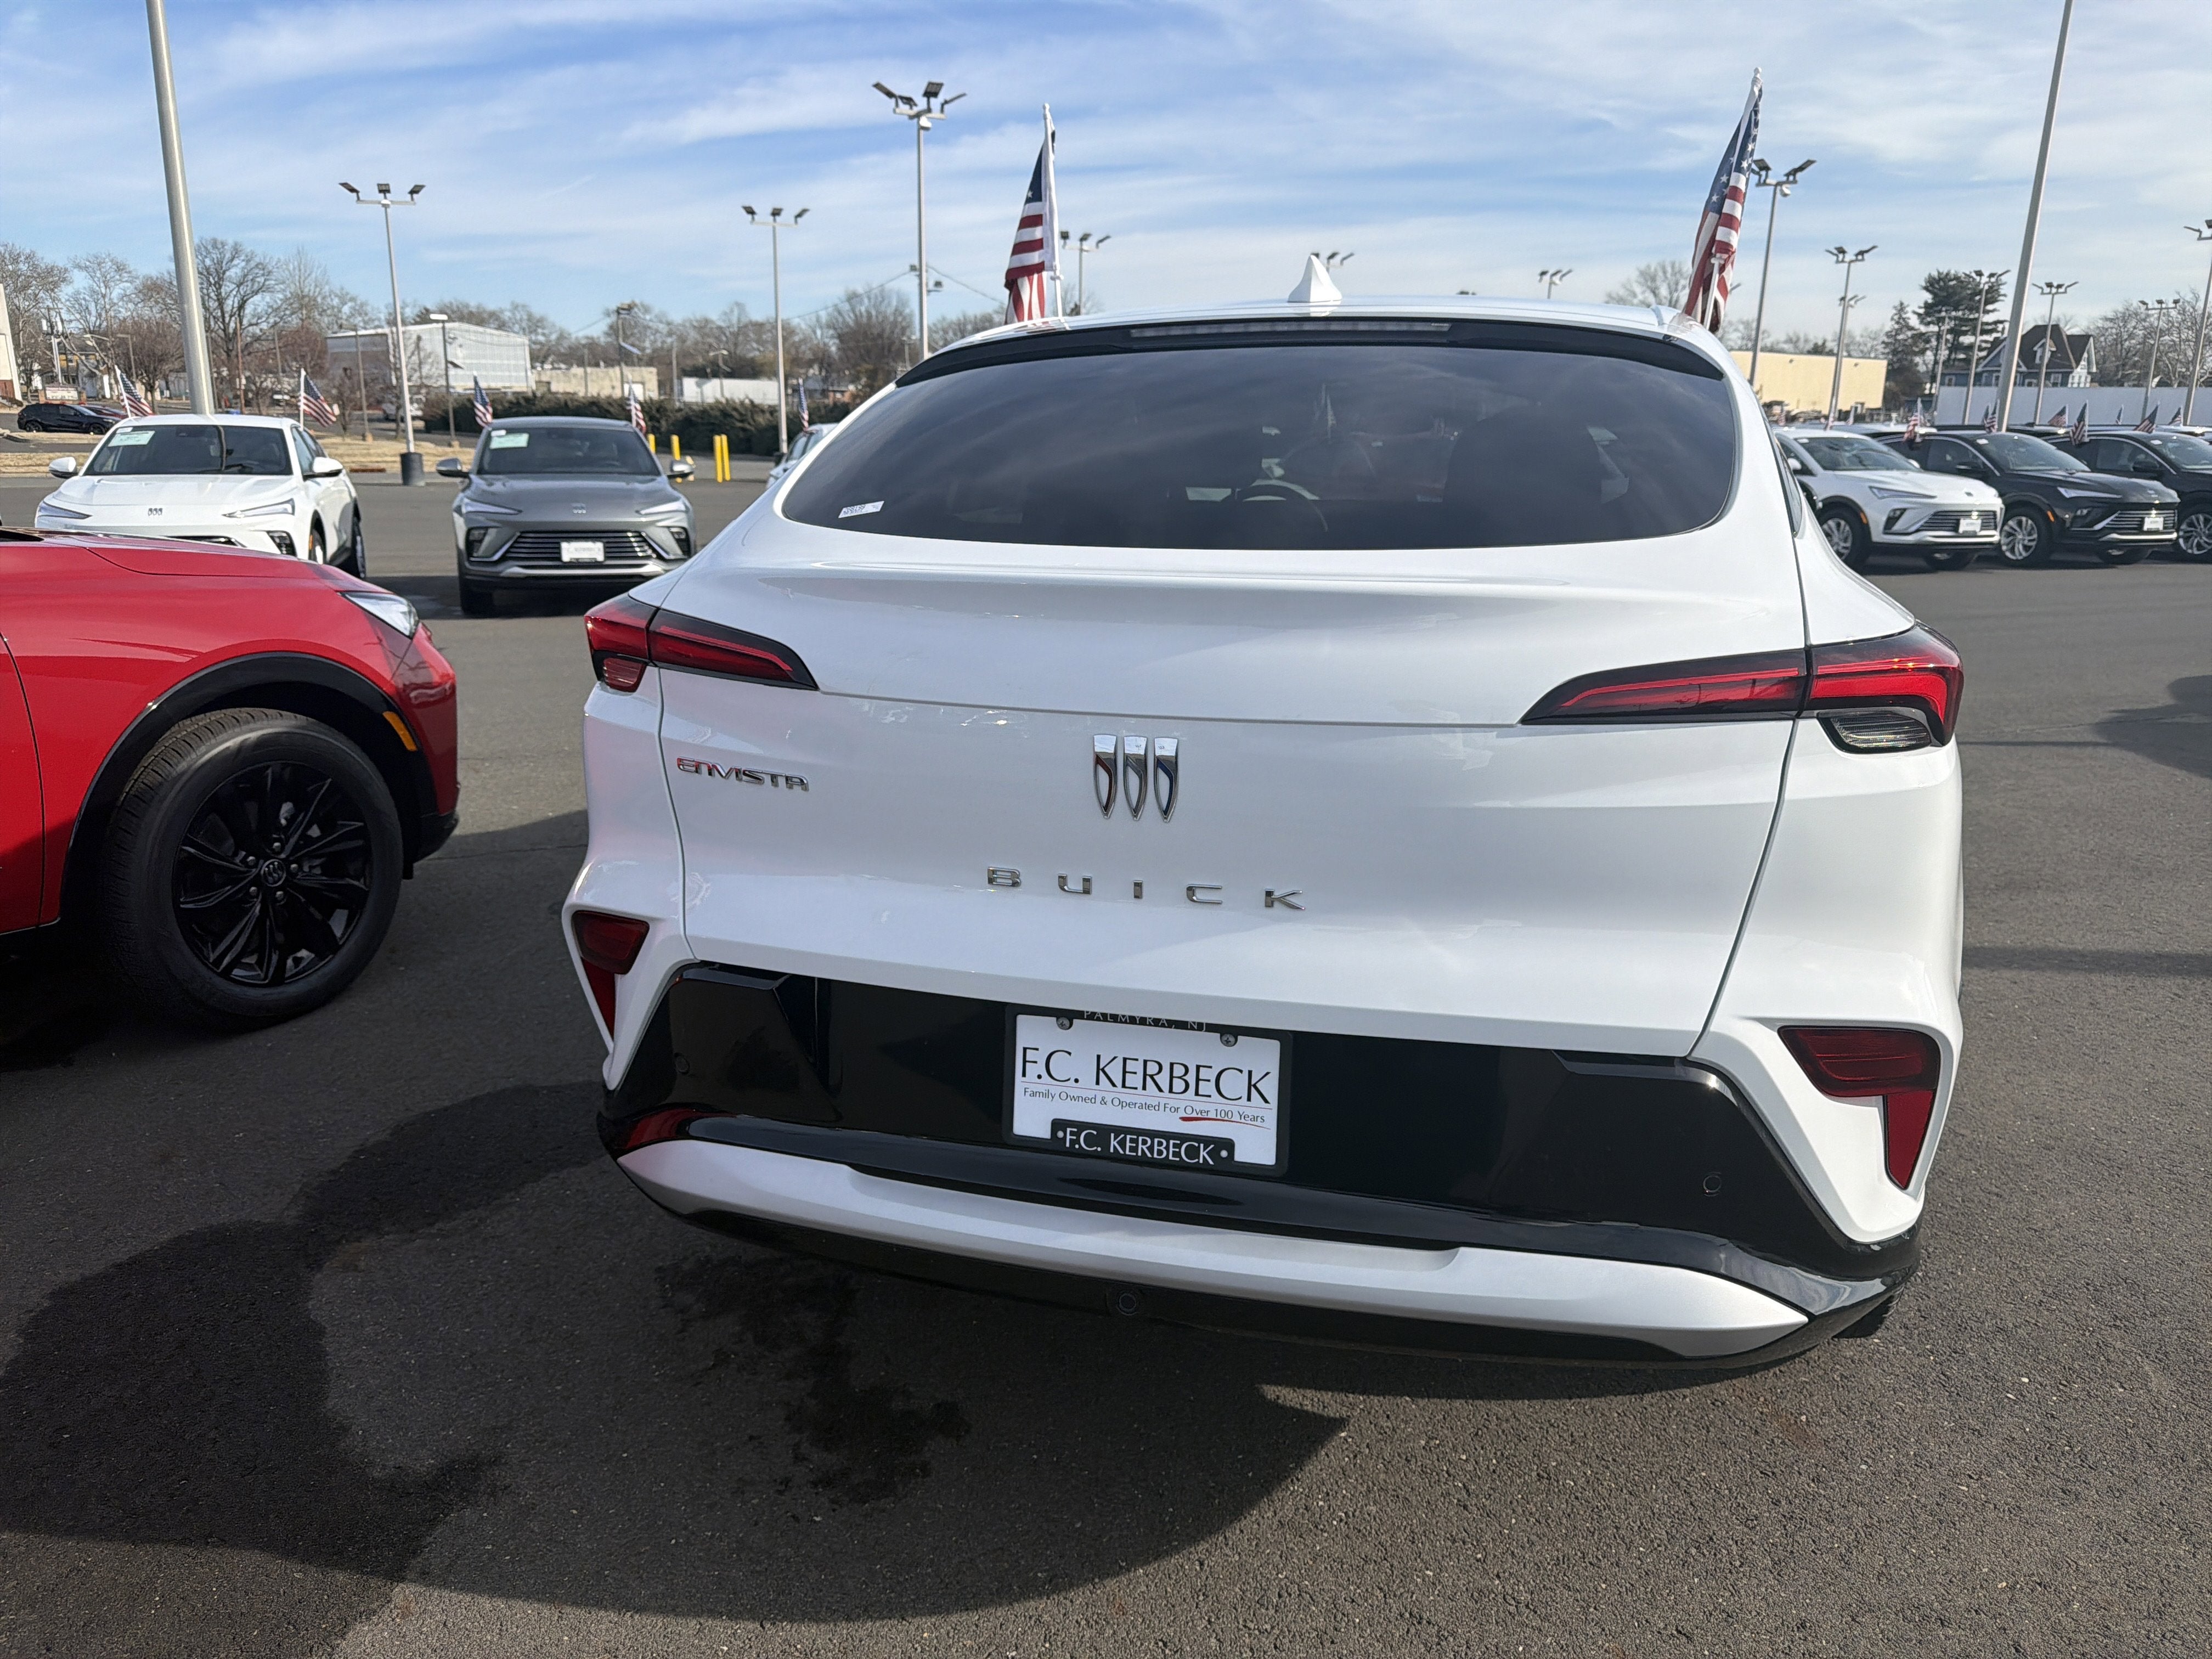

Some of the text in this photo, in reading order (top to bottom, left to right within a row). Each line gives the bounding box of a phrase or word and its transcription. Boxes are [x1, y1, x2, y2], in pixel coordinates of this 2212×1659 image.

[987, 866, 1306, 910] BUICK
[1084, 1011, 1206, 1032] PALMYRA, NJ
[1021, 1046, 1272, 1104] F.C. KERBECK
[1024, 1087, 1266, 1124] Family Owned & Operated For Over 100 Years
[1065, 1127, 1216, 1165] F.C. KERBECK
